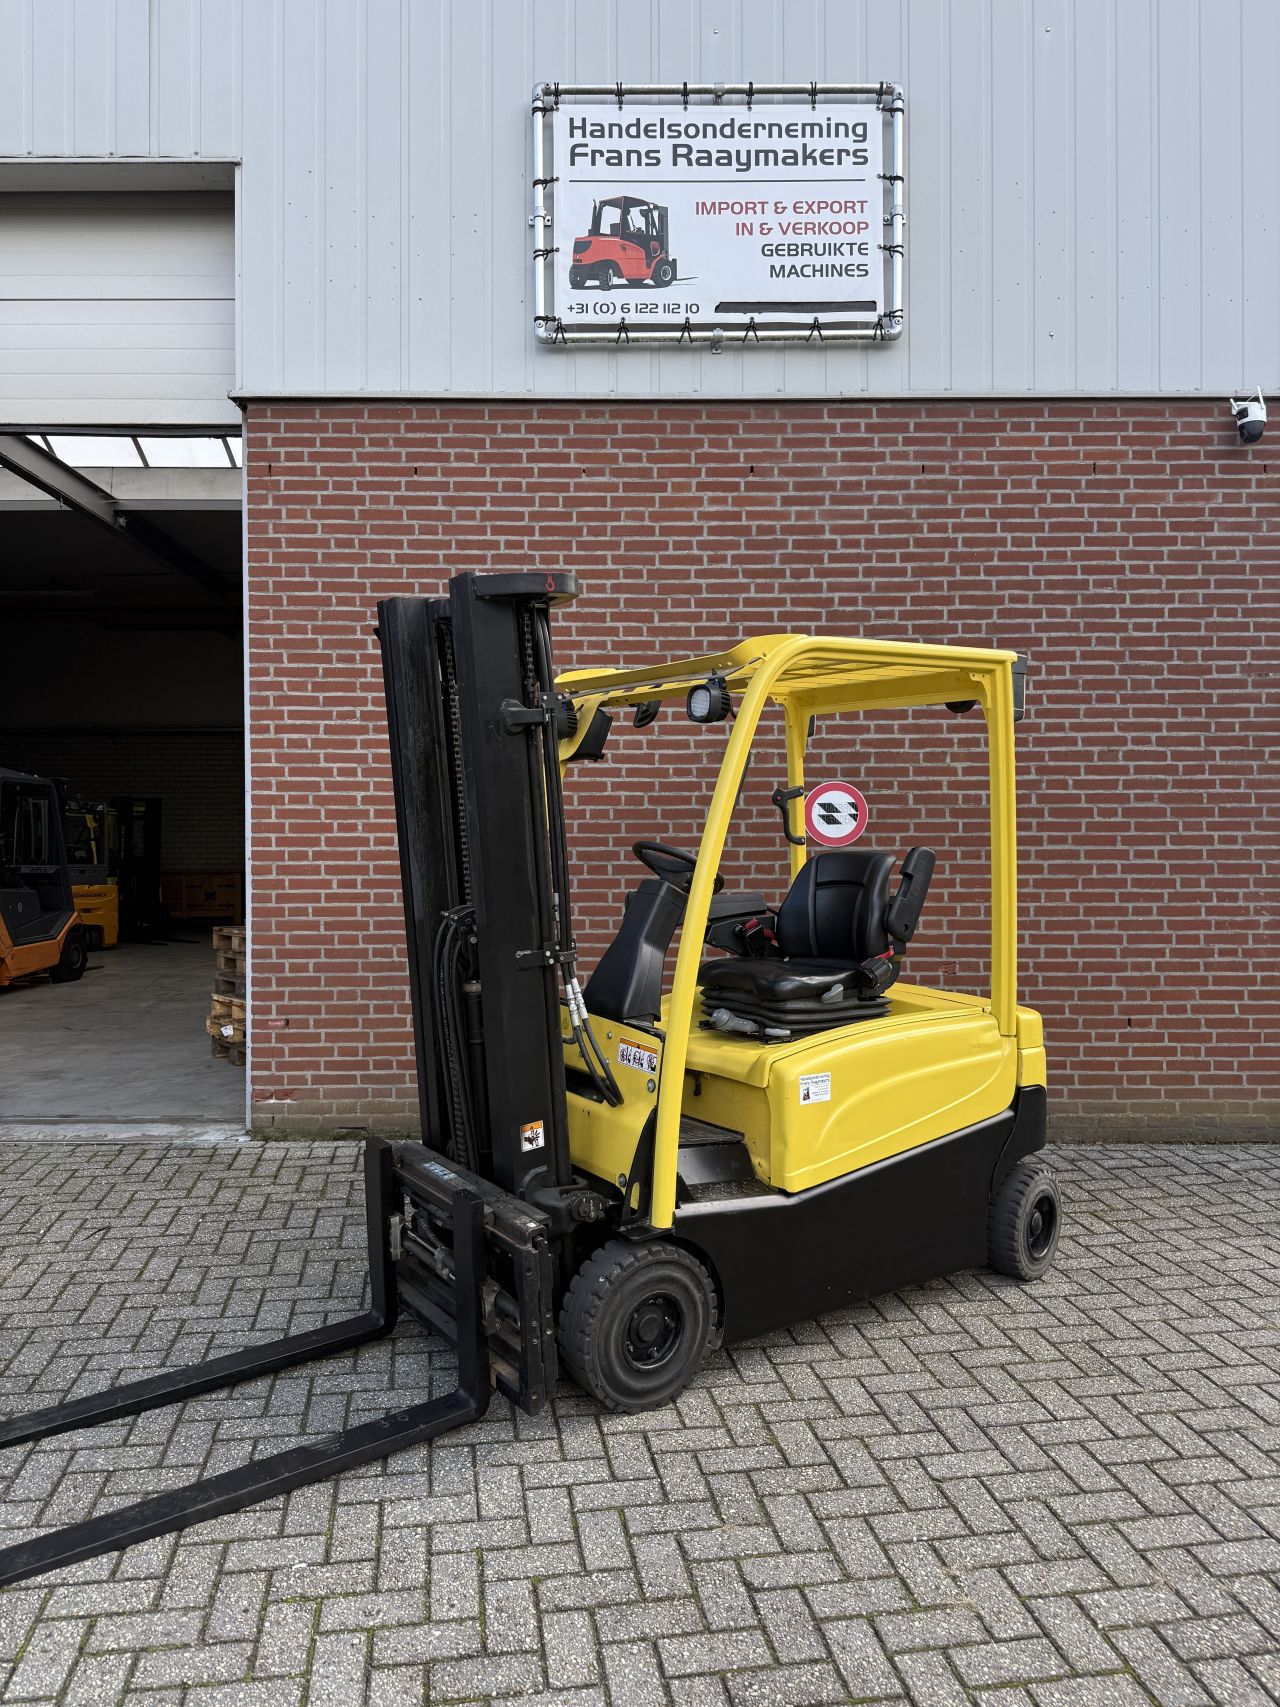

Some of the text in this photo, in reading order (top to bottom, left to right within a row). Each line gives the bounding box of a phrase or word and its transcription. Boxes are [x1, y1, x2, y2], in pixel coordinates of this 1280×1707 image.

[569, 117, 868, 143] Handelsonderneming
[569, 143, 869, 172] Frans Raaymakers
[695, 200, 868, 215] IMPORT & EXPORT
[735, 221, 869, 236] IN & VERKOOP
[761, 242, 869, 257] GEBRUIKTE
[769, 263, 869, 278] MACHINES
[567, 301, 700, 315] +31 (0) 6 122 112 10
